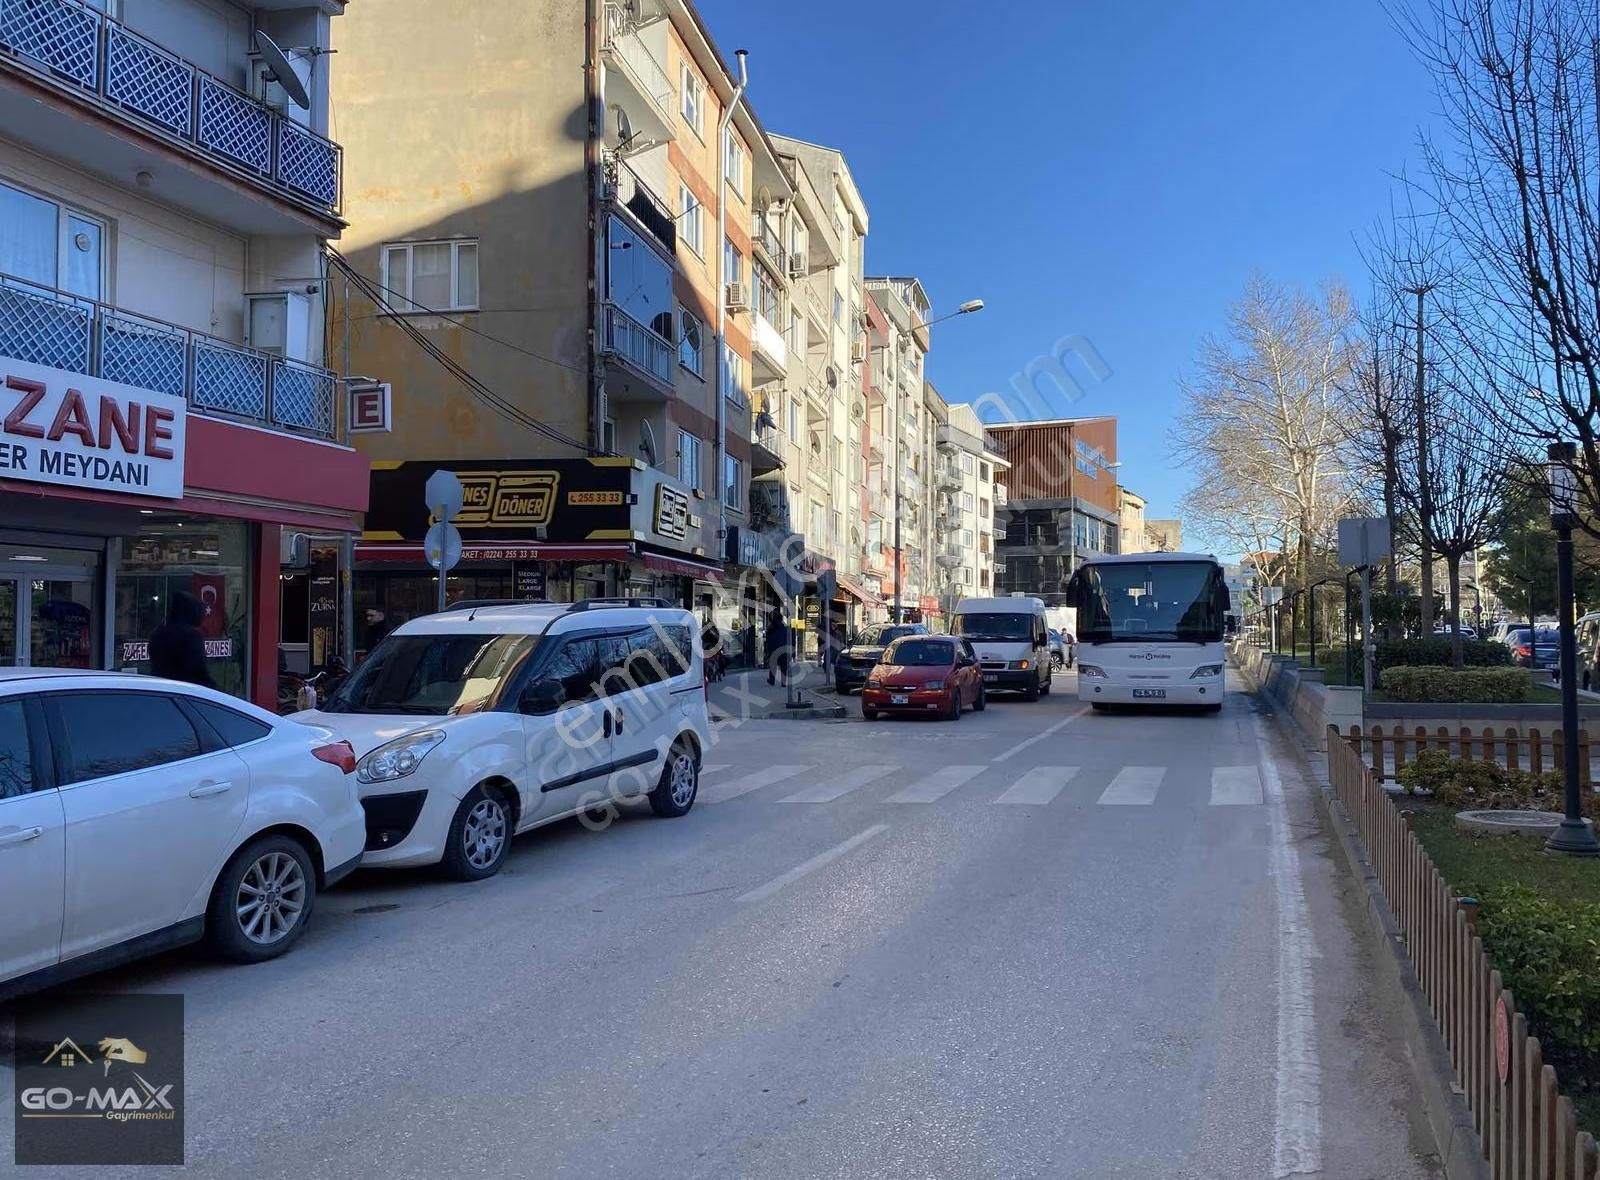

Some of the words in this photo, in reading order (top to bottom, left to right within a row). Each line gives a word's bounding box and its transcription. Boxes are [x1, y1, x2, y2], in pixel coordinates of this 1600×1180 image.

[0, 374, 175, 460] ZANE
[358, 395, 379, 424] E
[39, 448, 149, 487] MEYDANI
[463, 486, 488, 505] NEŞ
[499, 495, 544, 515] DÖNER
[578, 493, 594, 503] 255
[596, 493, 607, 503] 33
[609, 493, 619, 503] 33
[461, 550, 479, 559] AKET
[505, 550, 517, 559] 255
[520, 550, 528, 559] 33
[530, 550, 538, 559] 33
[123, 642, 150, 661] ZAFE
[204, 639, 232, 657] ZANESİ
